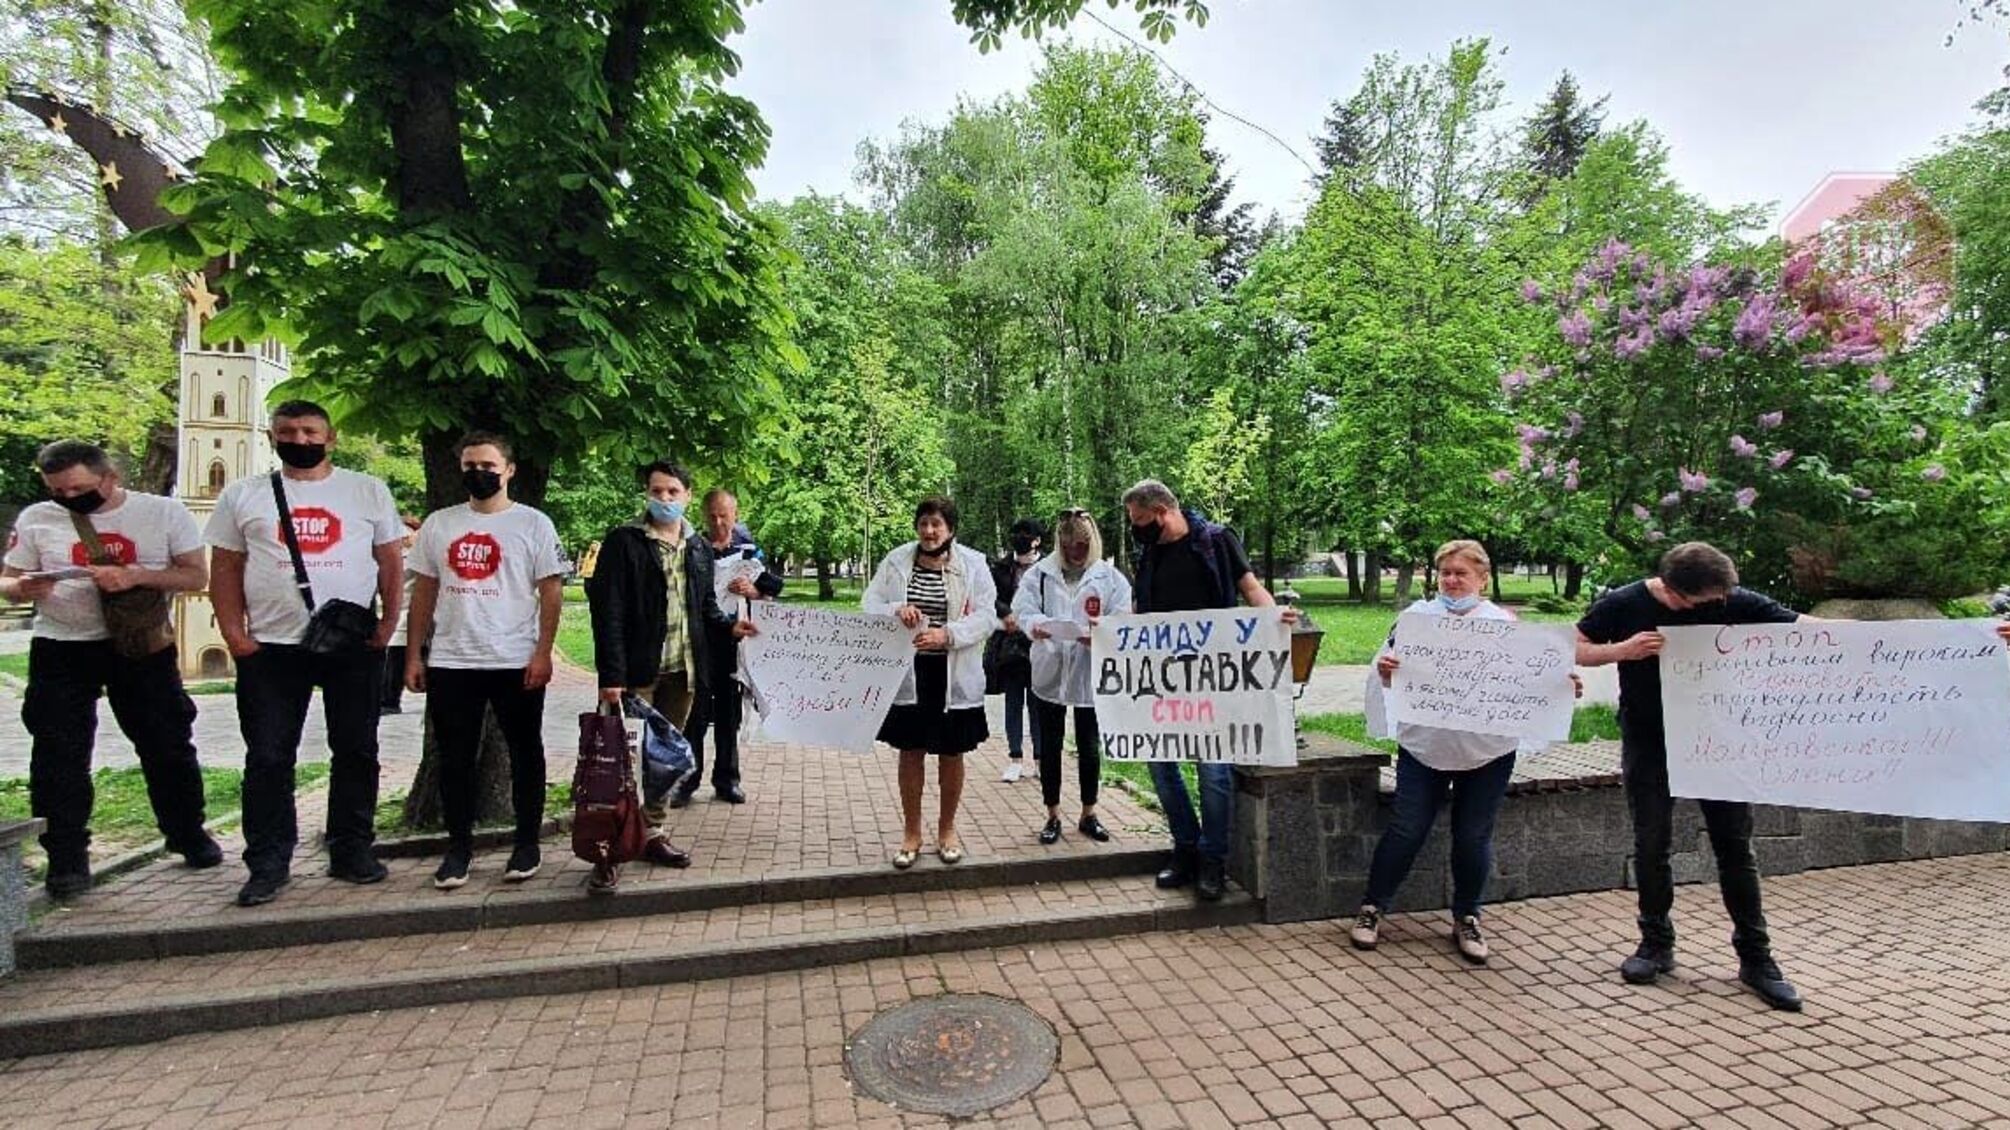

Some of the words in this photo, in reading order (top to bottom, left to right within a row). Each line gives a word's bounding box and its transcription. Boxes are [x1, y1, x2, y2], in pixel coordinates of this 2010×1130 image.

[291, 517, 330, 535] STOP
[457, 542, 492, 562] STOP
[1234, 617, 1257, 645] У
[1096, 650, 1290, 701] ВІДСТАВКУ
[1151, 699, 1216, 724] СТОП
